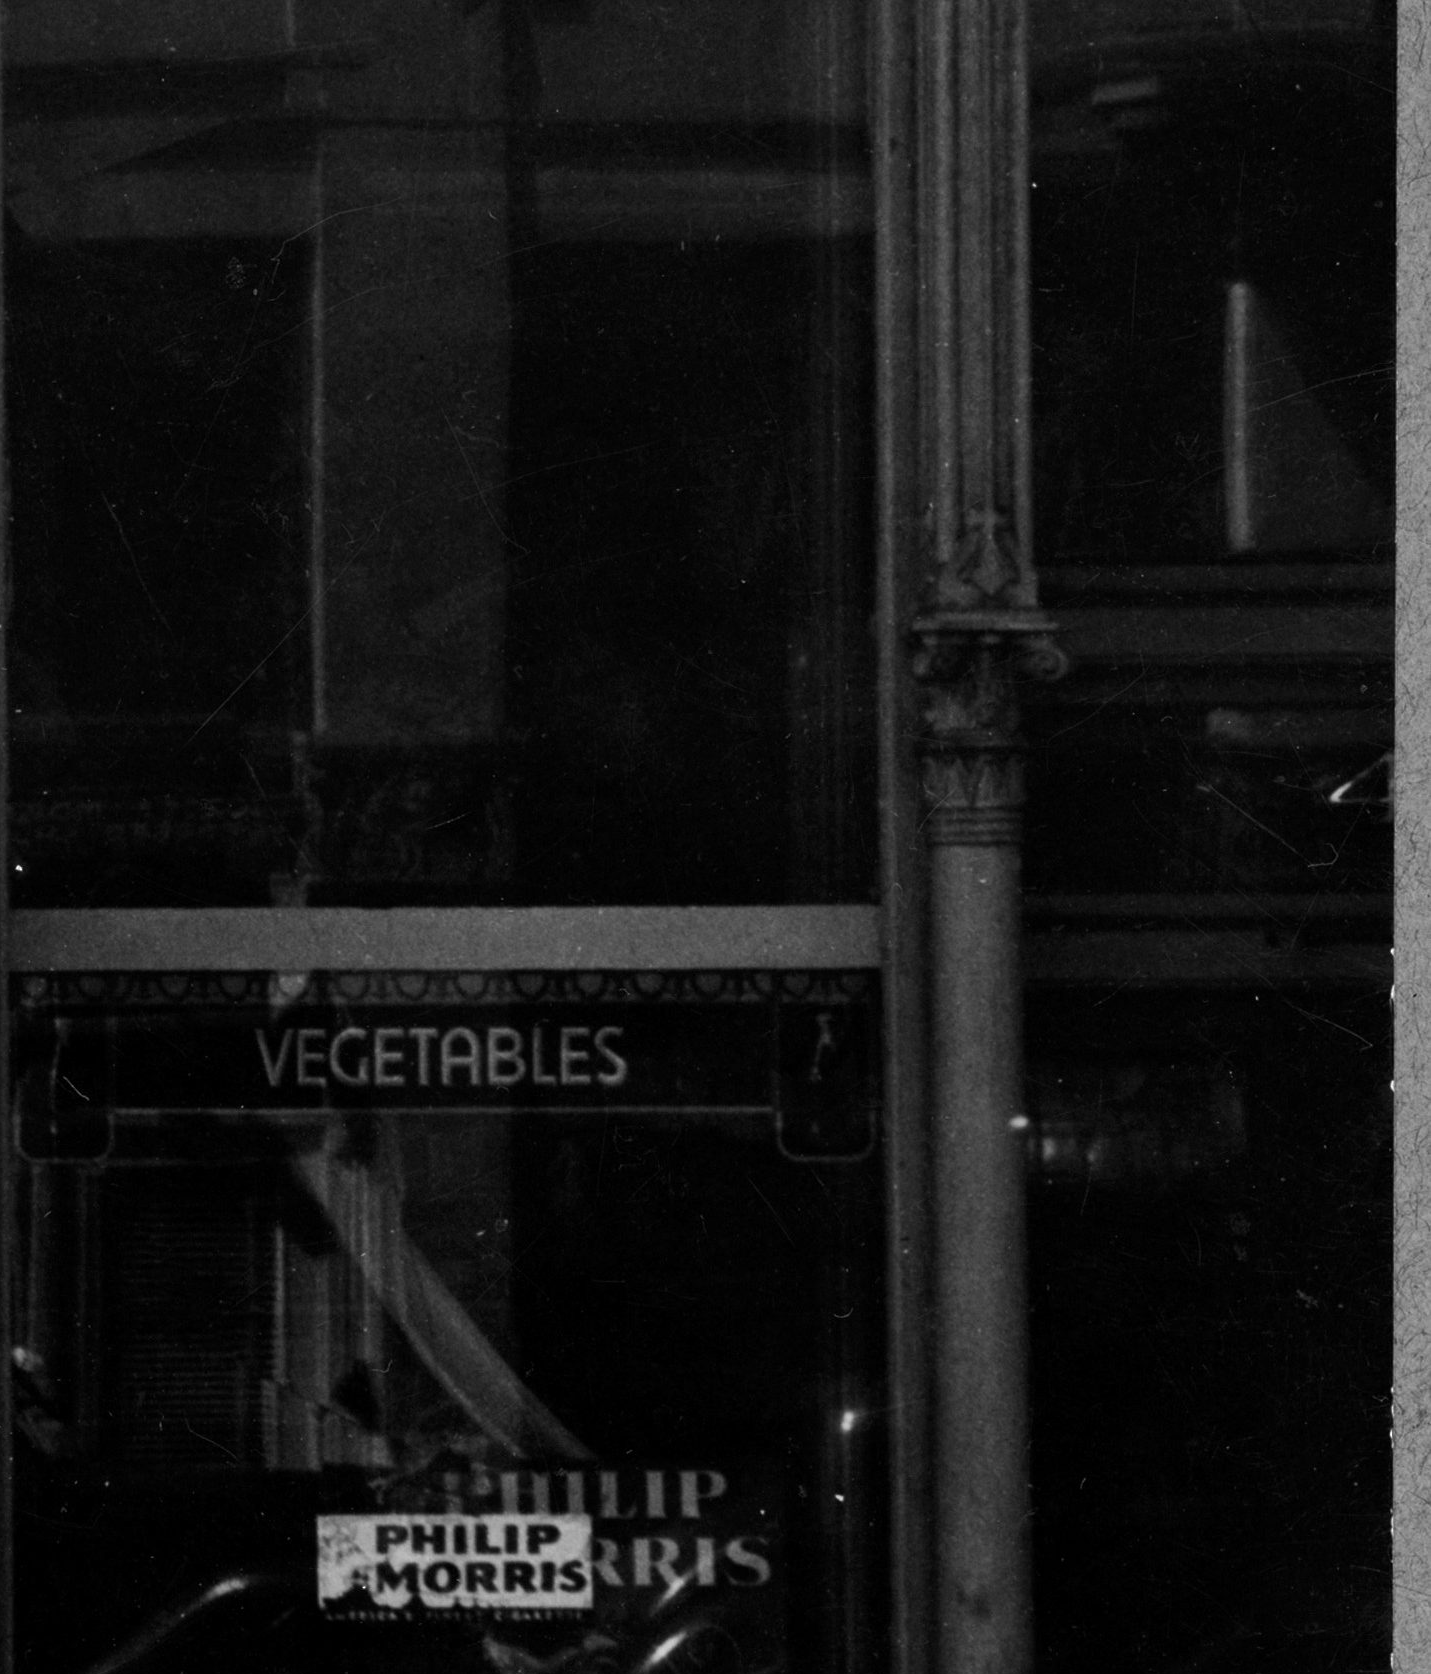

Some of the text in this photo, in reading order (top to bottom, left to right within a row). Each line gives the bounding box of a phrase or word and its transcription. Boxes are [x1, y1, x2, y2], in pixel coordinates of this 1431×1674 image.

[256, 1022, 630, 1089] VEGETABLES
[376, 1523, 561, 1556] PHILIP
[375, 1560, 587, 1595] MORRIS
